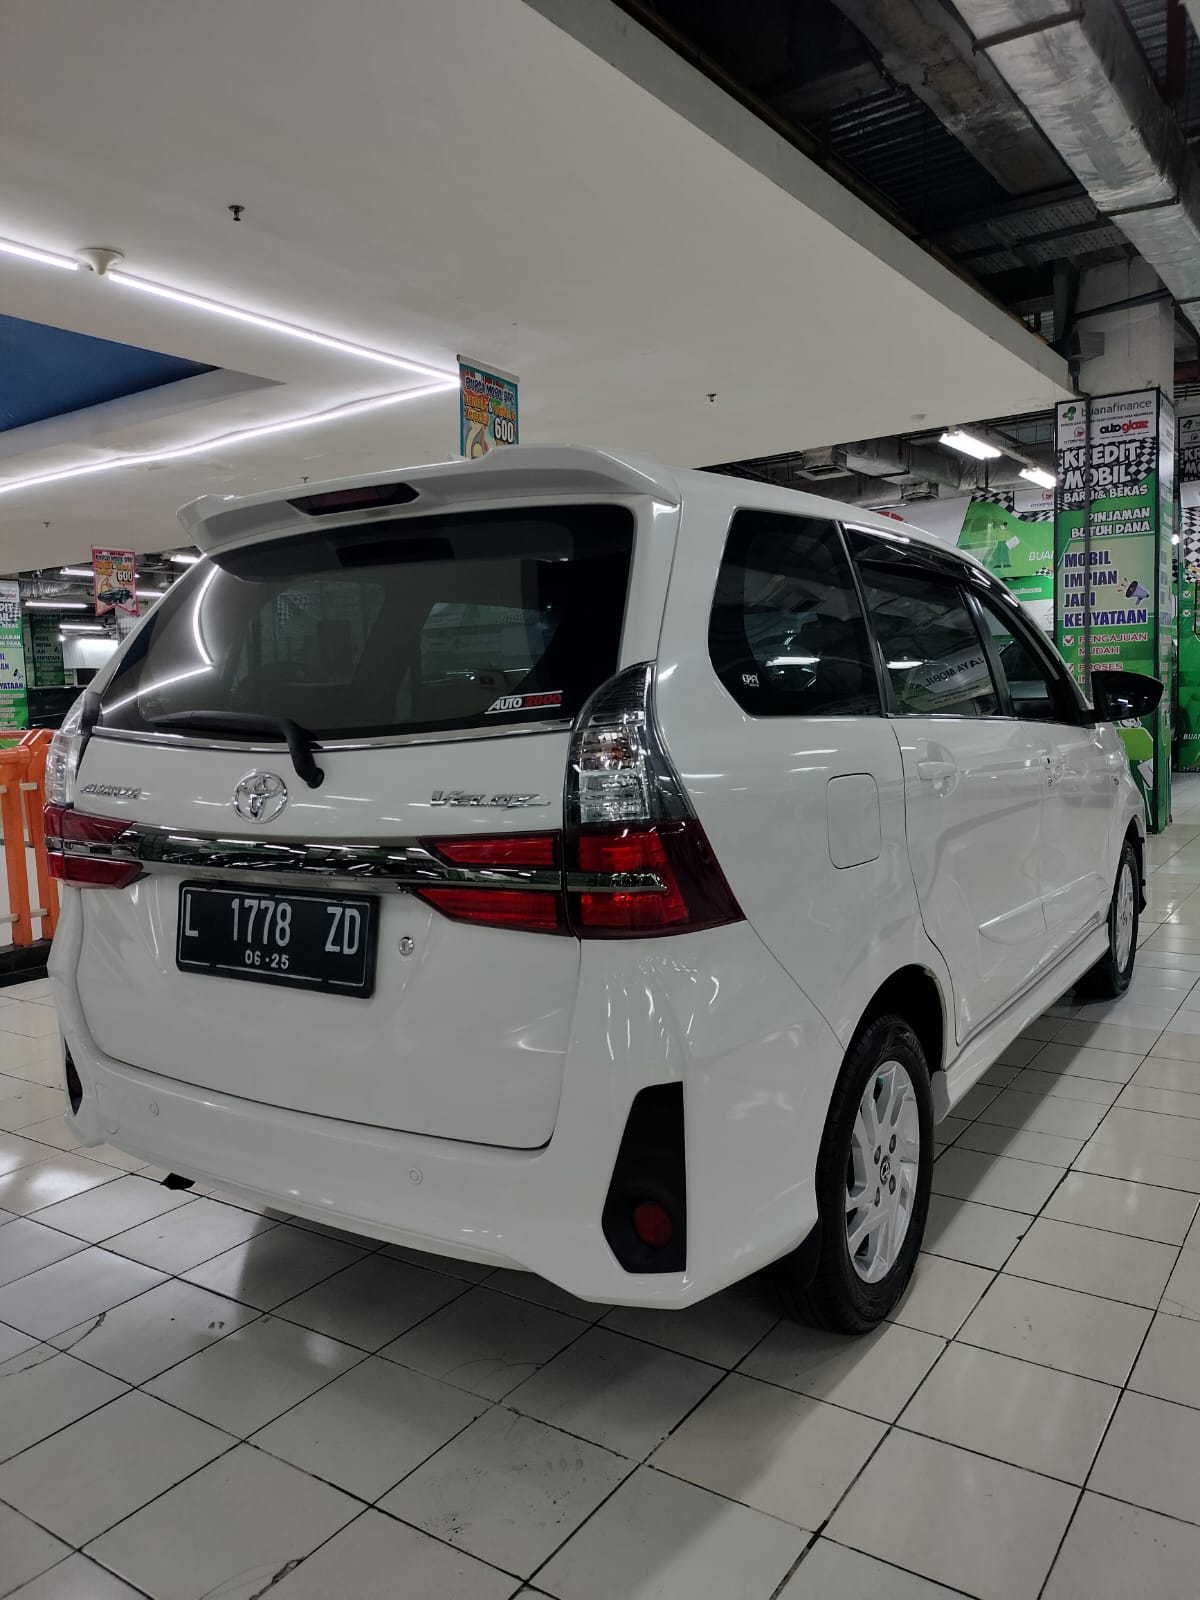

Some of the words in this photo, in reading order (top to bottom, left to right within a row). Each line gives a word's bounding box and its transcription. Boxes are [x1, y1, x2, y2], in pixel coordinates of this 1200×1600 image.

[494, 417, 514, 443] 600
[1064, 465, 1131, 490] MOBIL
[1109, 484, 1148, 497] BEKAS
[1115, 521, 1150, 534] DANA
[1064, 550, 1111, 568] MOBIL
[117, 570, 133, 582] 600
[488, 697, 522, 711] AUTO
[524, 693, 561, 707] 2000
[185, 893, 199, 937] L
[231, 898, 292, 947] 1778
[324, 906, 361, 955] ZD
